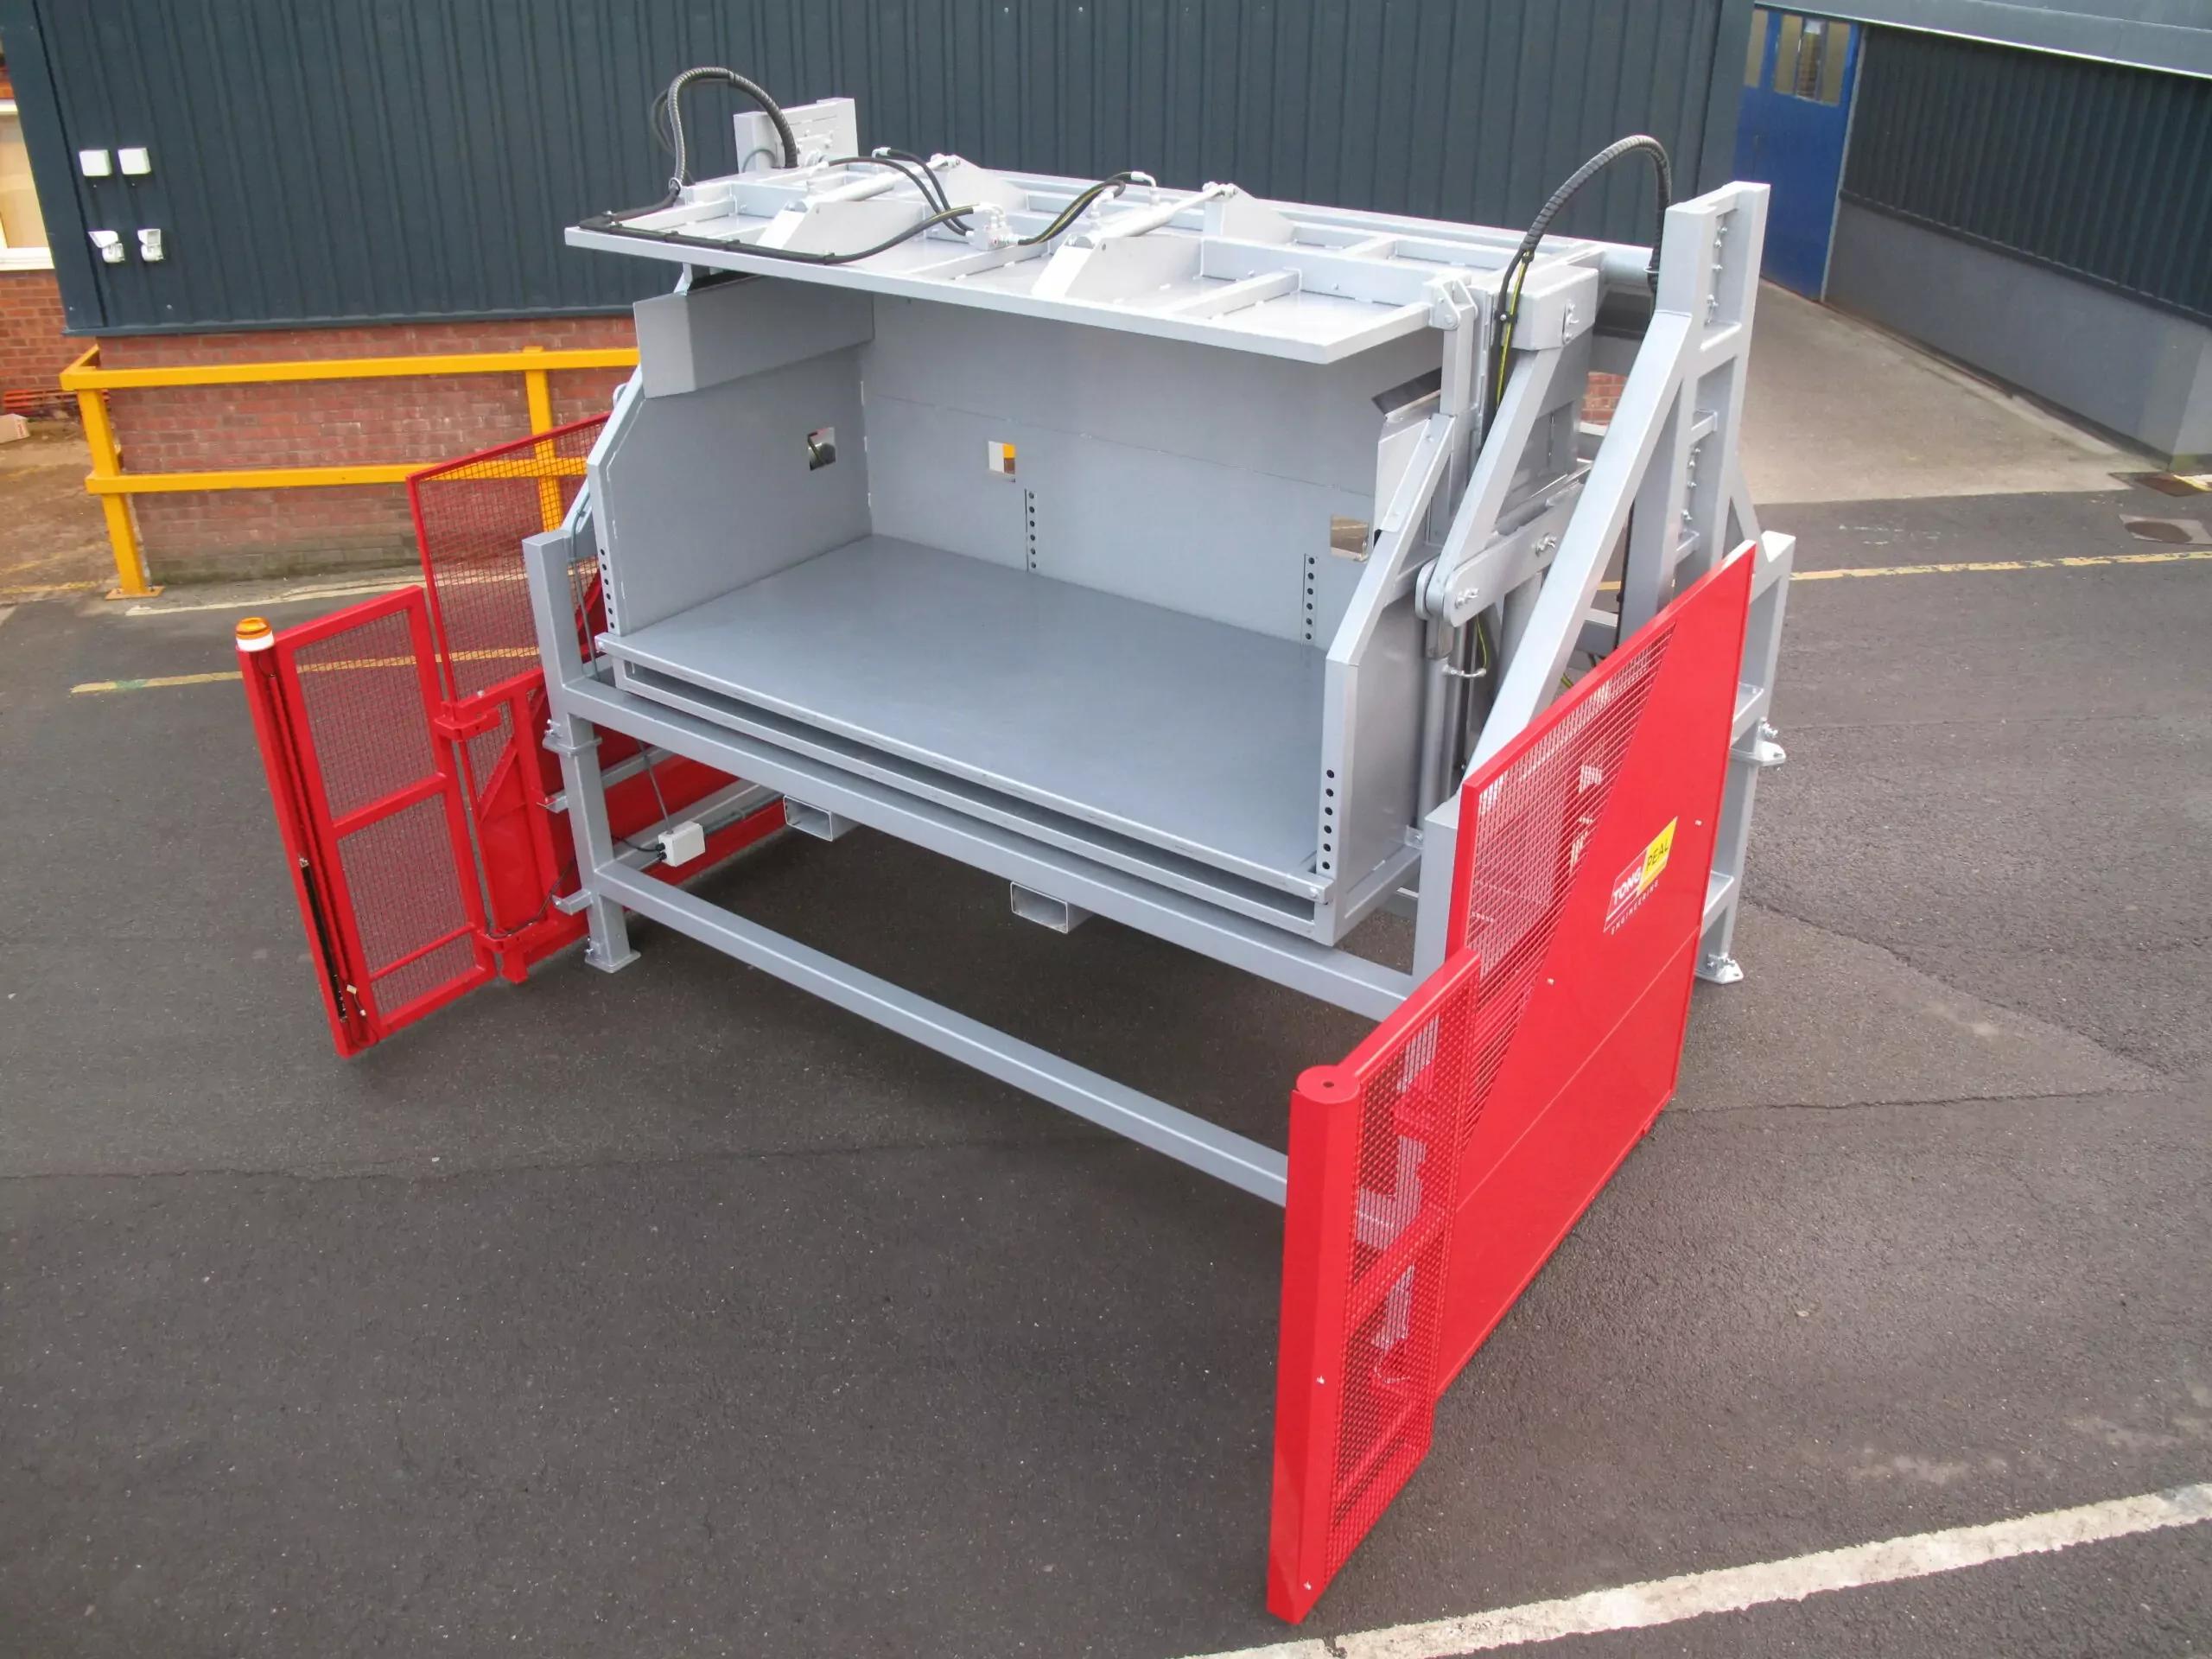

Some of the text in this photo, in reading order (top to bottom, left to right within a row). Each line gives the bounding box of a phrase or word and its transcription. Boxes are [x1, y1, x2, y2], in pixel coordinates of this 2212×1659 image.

[1613, 841, 1669, 906] TONG PEAL
[1611, 880, 1659, 935] ENGINEERING
